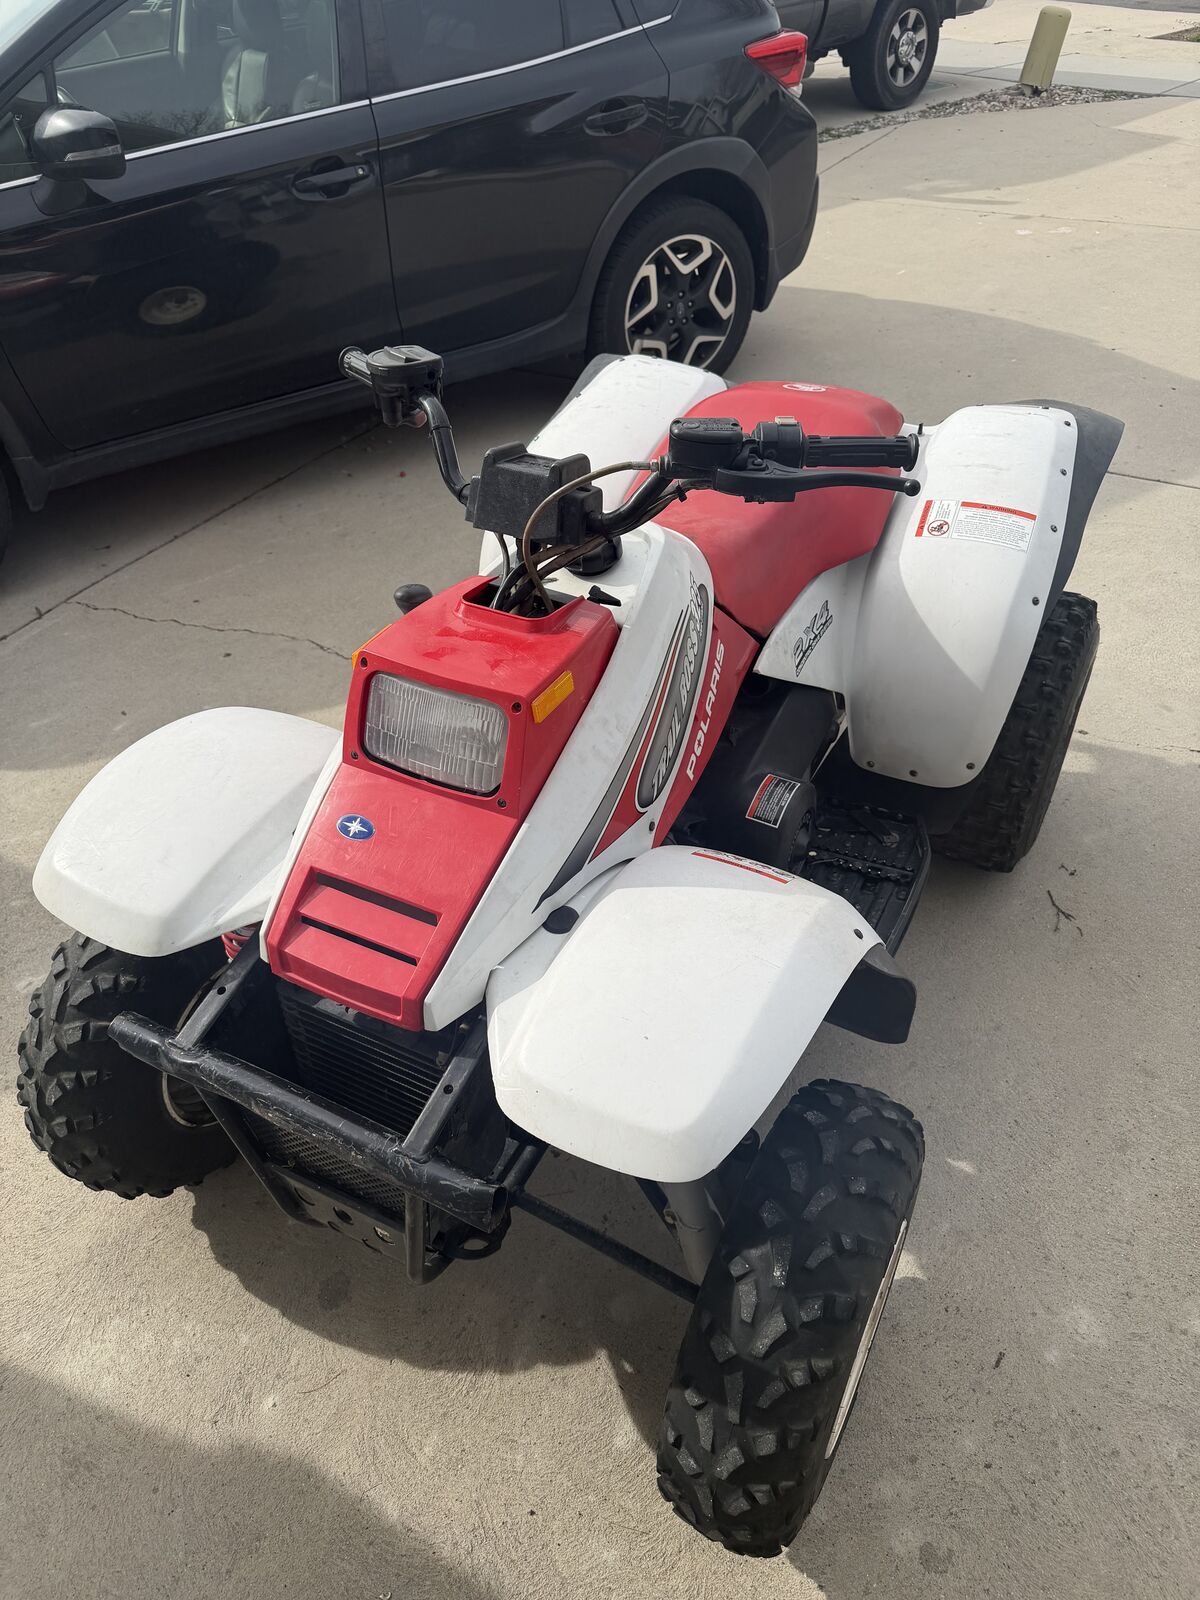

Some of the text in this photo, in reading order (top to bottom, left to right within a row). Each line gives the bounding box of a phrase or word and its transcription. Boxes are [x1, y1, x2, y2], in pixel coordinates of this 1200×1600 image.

[651, 703, 681, 801] TRAIL
[679, 618, 698, 715] BOSS
[687, 639, 725, 781] POLARIS
